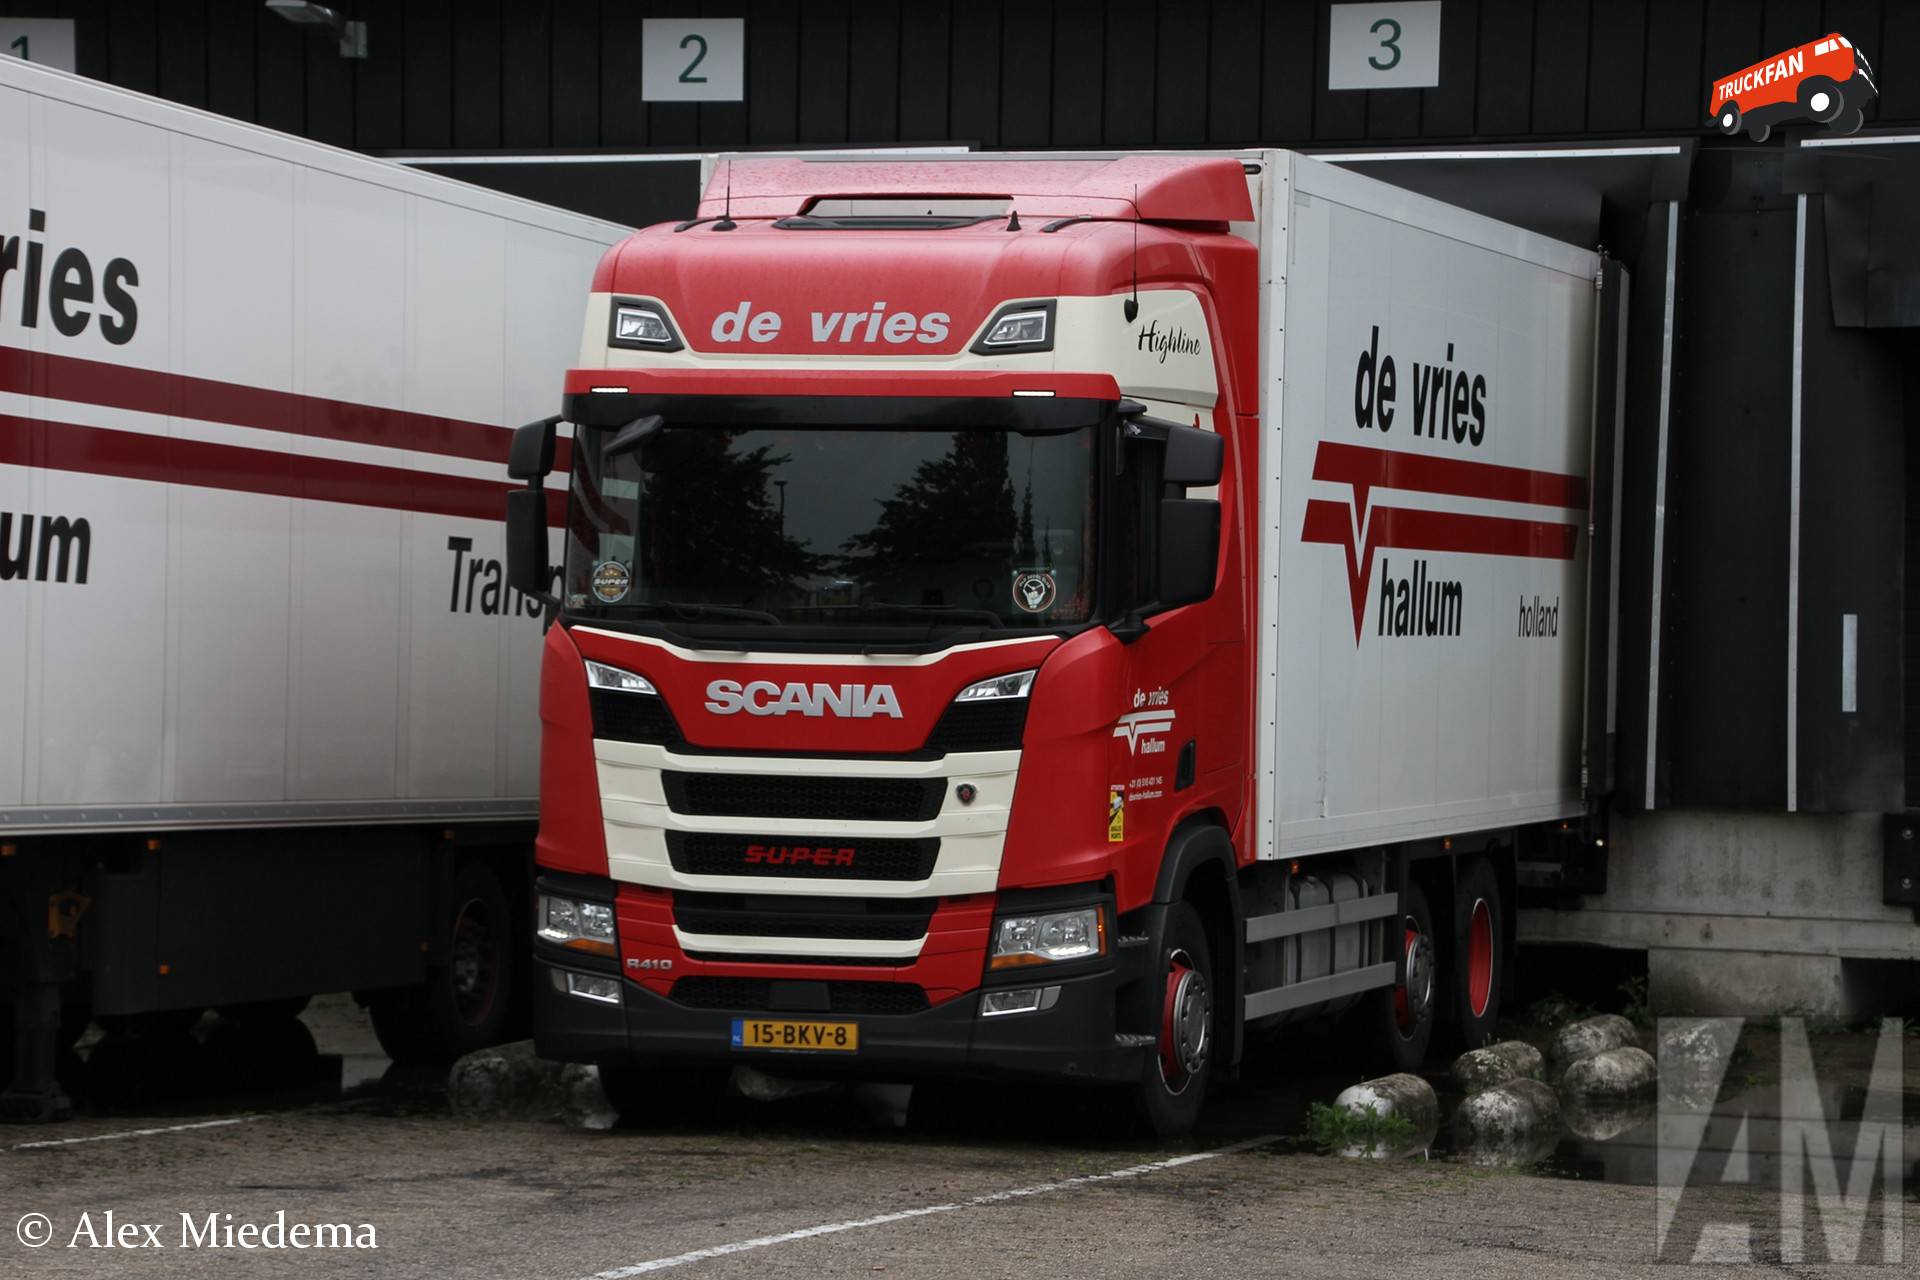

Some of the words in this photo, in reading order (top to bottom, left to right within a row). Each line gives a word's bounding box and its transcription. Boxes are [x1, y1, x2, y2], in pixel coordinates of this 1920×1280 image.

[678, 34, 707, 84] 2
[1367, 18, 1401, 70] 3
[711, 301, 781, 343] de
[810, 302, 951, 344] vries
[1138, 319, 1201, 364] Highline
[1354, 325, 1396, 432] de
[1413, 343, 1487, 446] vries
[1378, 558, 1462, 637] hallum
[1518, 594, 1559, 637] holland
[704, 680, 903, 718] SCANIA
[1133, 688, 1146, 708] de
[1147, 686, 1169, 706] vries
[1141, 737, 1165, 754] hallum
[744, 846, 856, 866] SUPER
[627, 958, 673, 970] R410
[752, 1024, 848, 1046] 15-BKV-8
